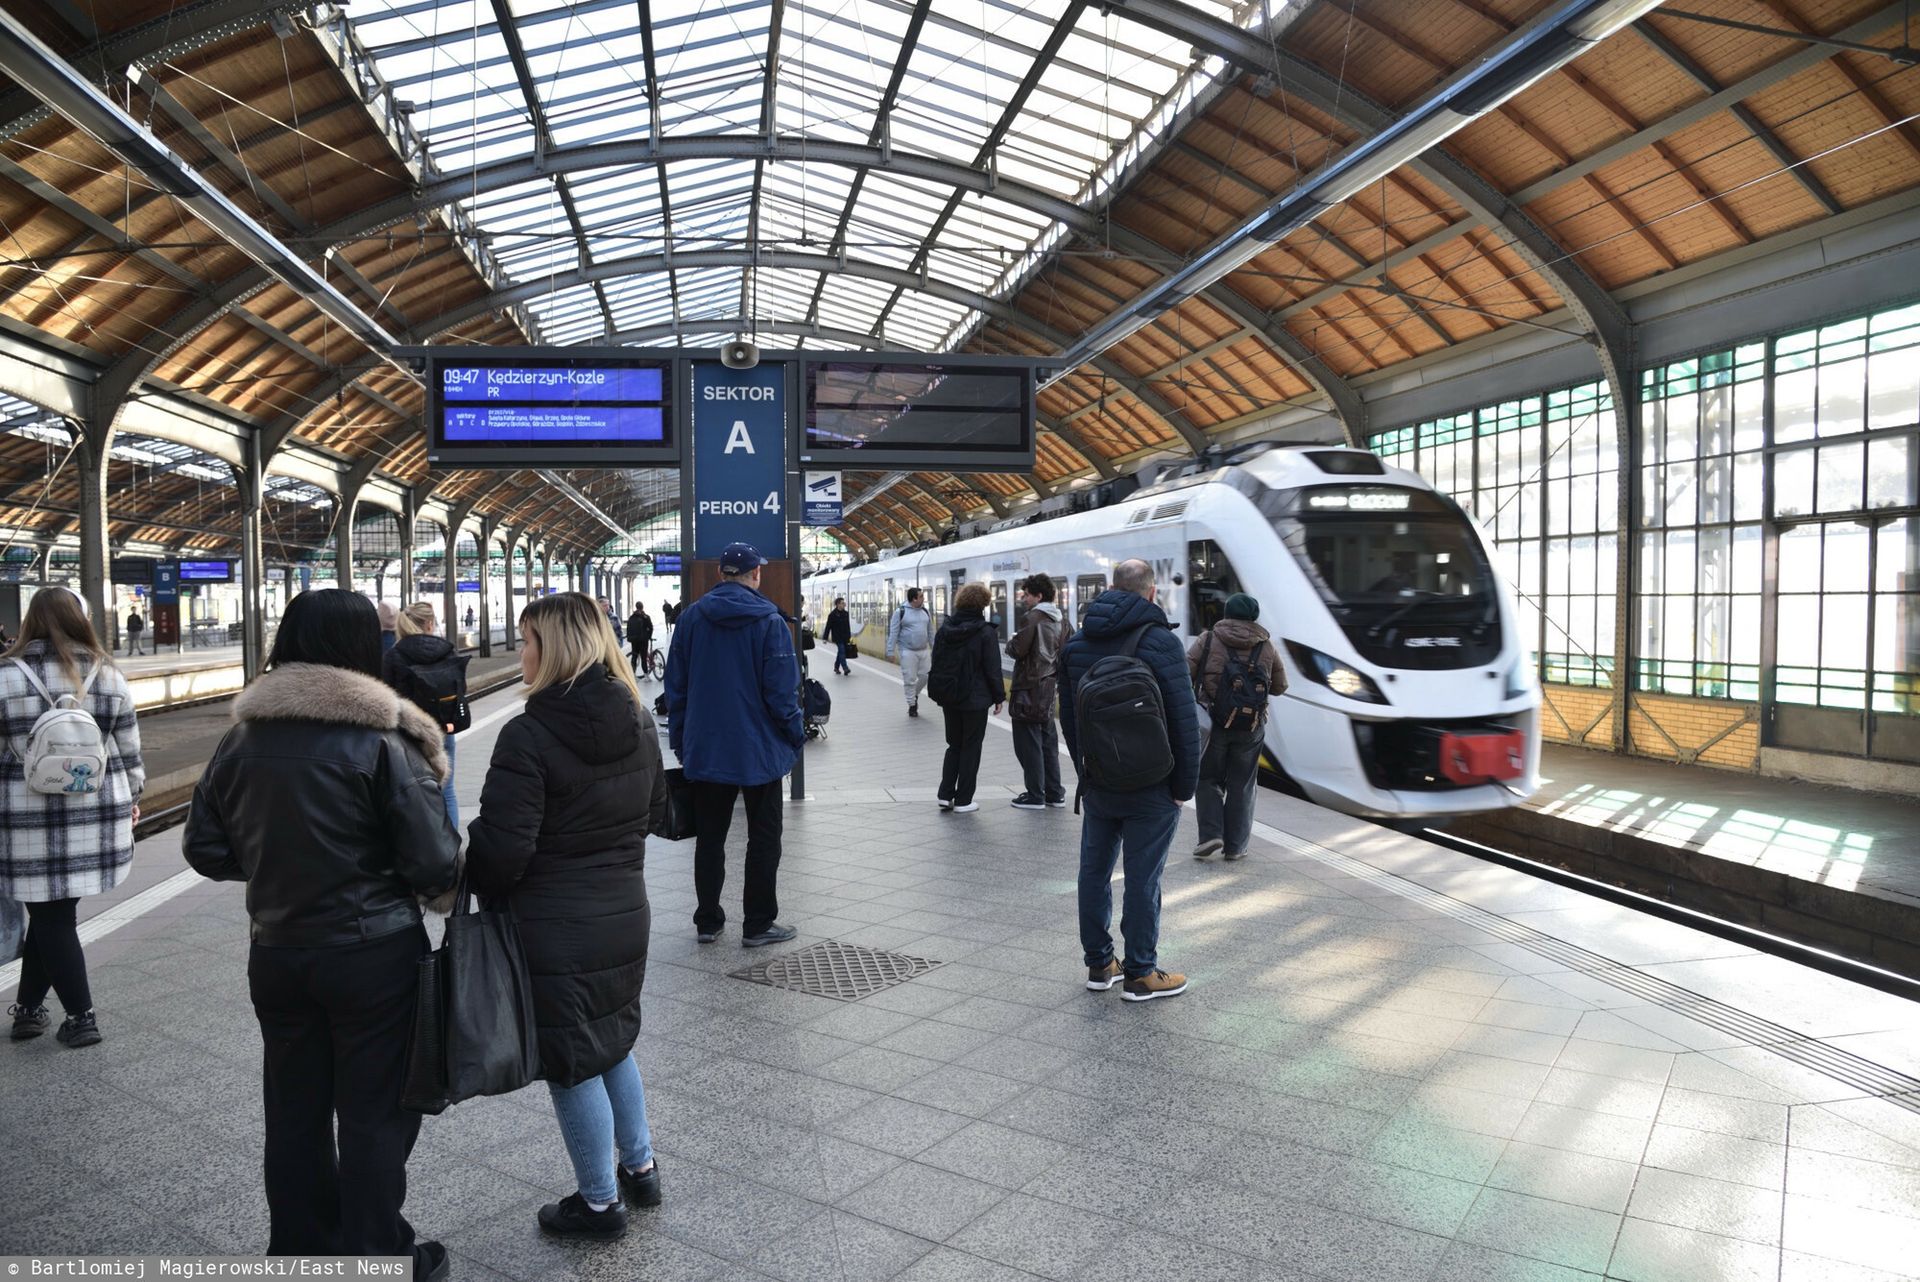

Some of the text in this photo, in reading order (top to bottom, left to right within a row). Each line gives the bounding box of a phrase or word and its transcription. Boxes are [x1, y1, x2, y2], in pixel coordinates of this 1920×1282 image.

[443, 369, 479, 384] 09:47
[487, 386, 500, 397] PR
[703, 386, 775, 401] SEKTOR
[724, 421, 756, 454] A
[699, 491, 781, 515] PERON 4
[161, 572, 170, 581] B
